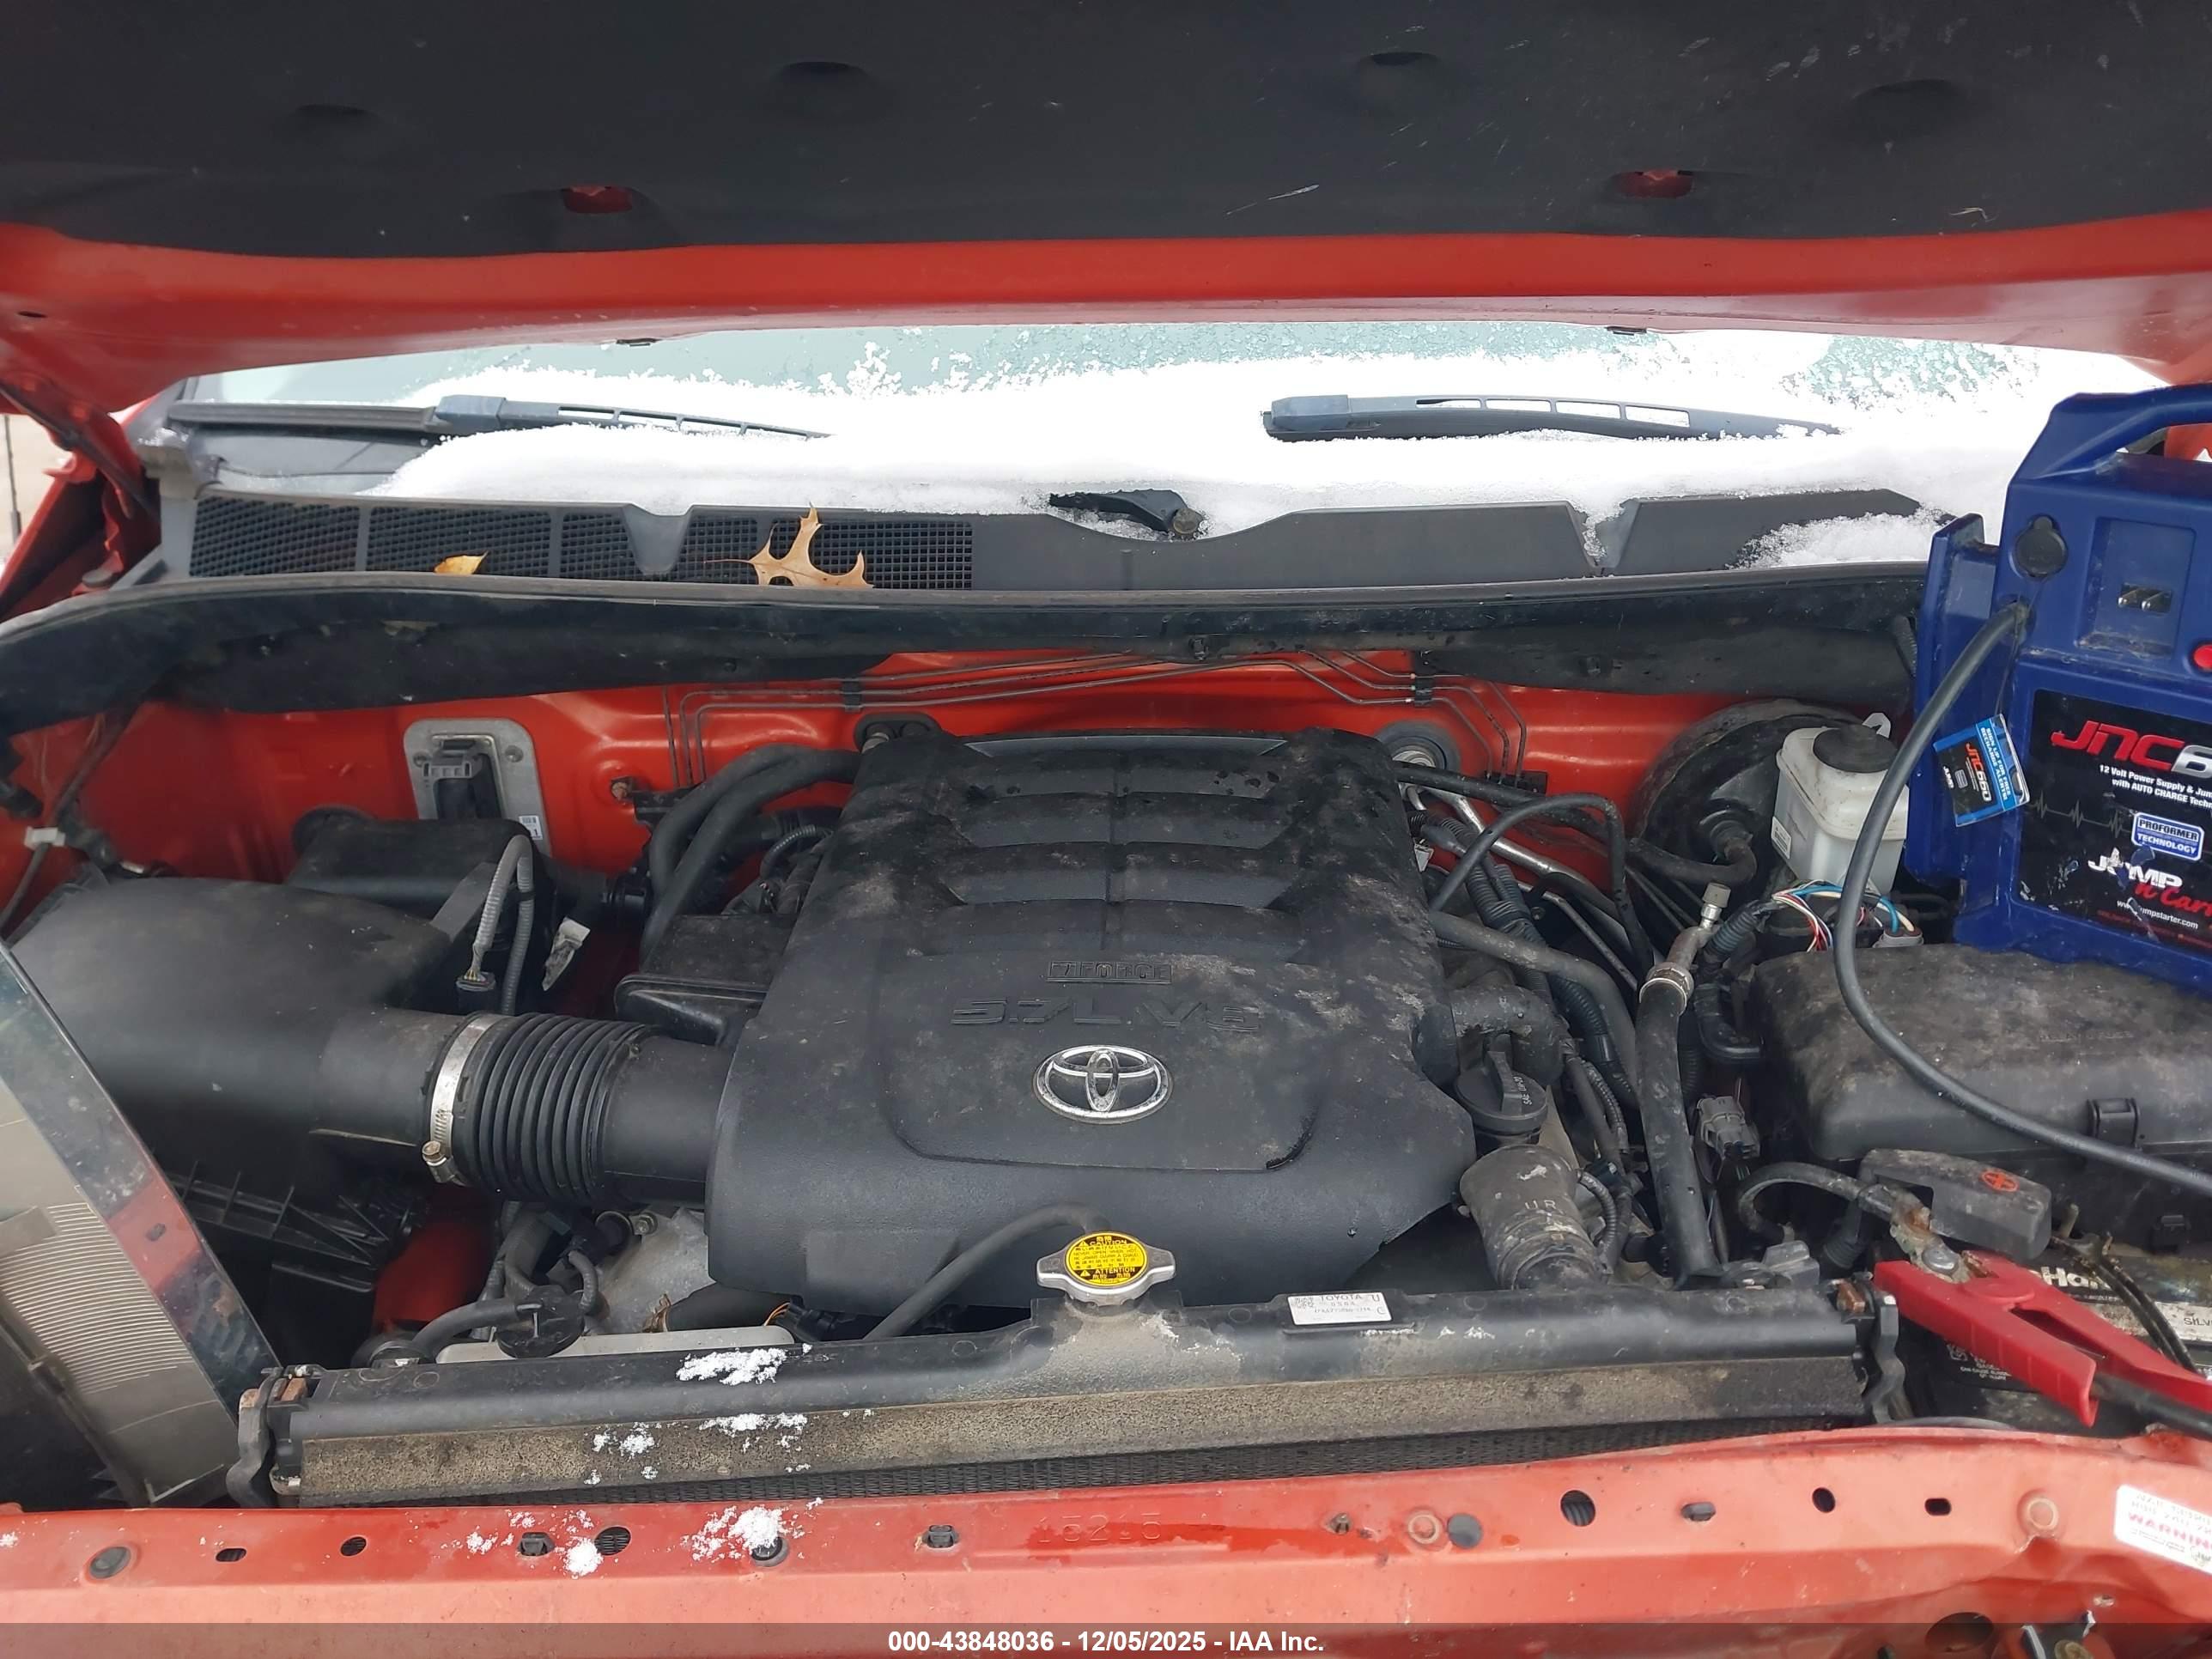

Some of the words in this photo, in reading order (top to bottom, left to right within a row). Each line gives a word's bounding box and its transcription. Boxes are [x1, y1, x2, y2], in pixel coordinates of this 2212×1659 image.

[2100, 764, 2110, 774] 12
[2111, 767, 2127, 777] Volt
[2129, 772, 2154, 785] Power
[2156, 777, 2185, 793] Supply
[2186, 785, 2194, 793] &
[2112, 779, 2130, 789] with
[2131, 783, 2153, 794] AUTO
[2154, 789, 2188, 803] CHARGE
[2138, 818, 2198, 841] PROFORMER
[2136, 833, 2197, 854] TECHNOLOGY
[2184, 1317, 2212, 1327] SILV
[2129, 1511, 2212, 1548] WARNIN
